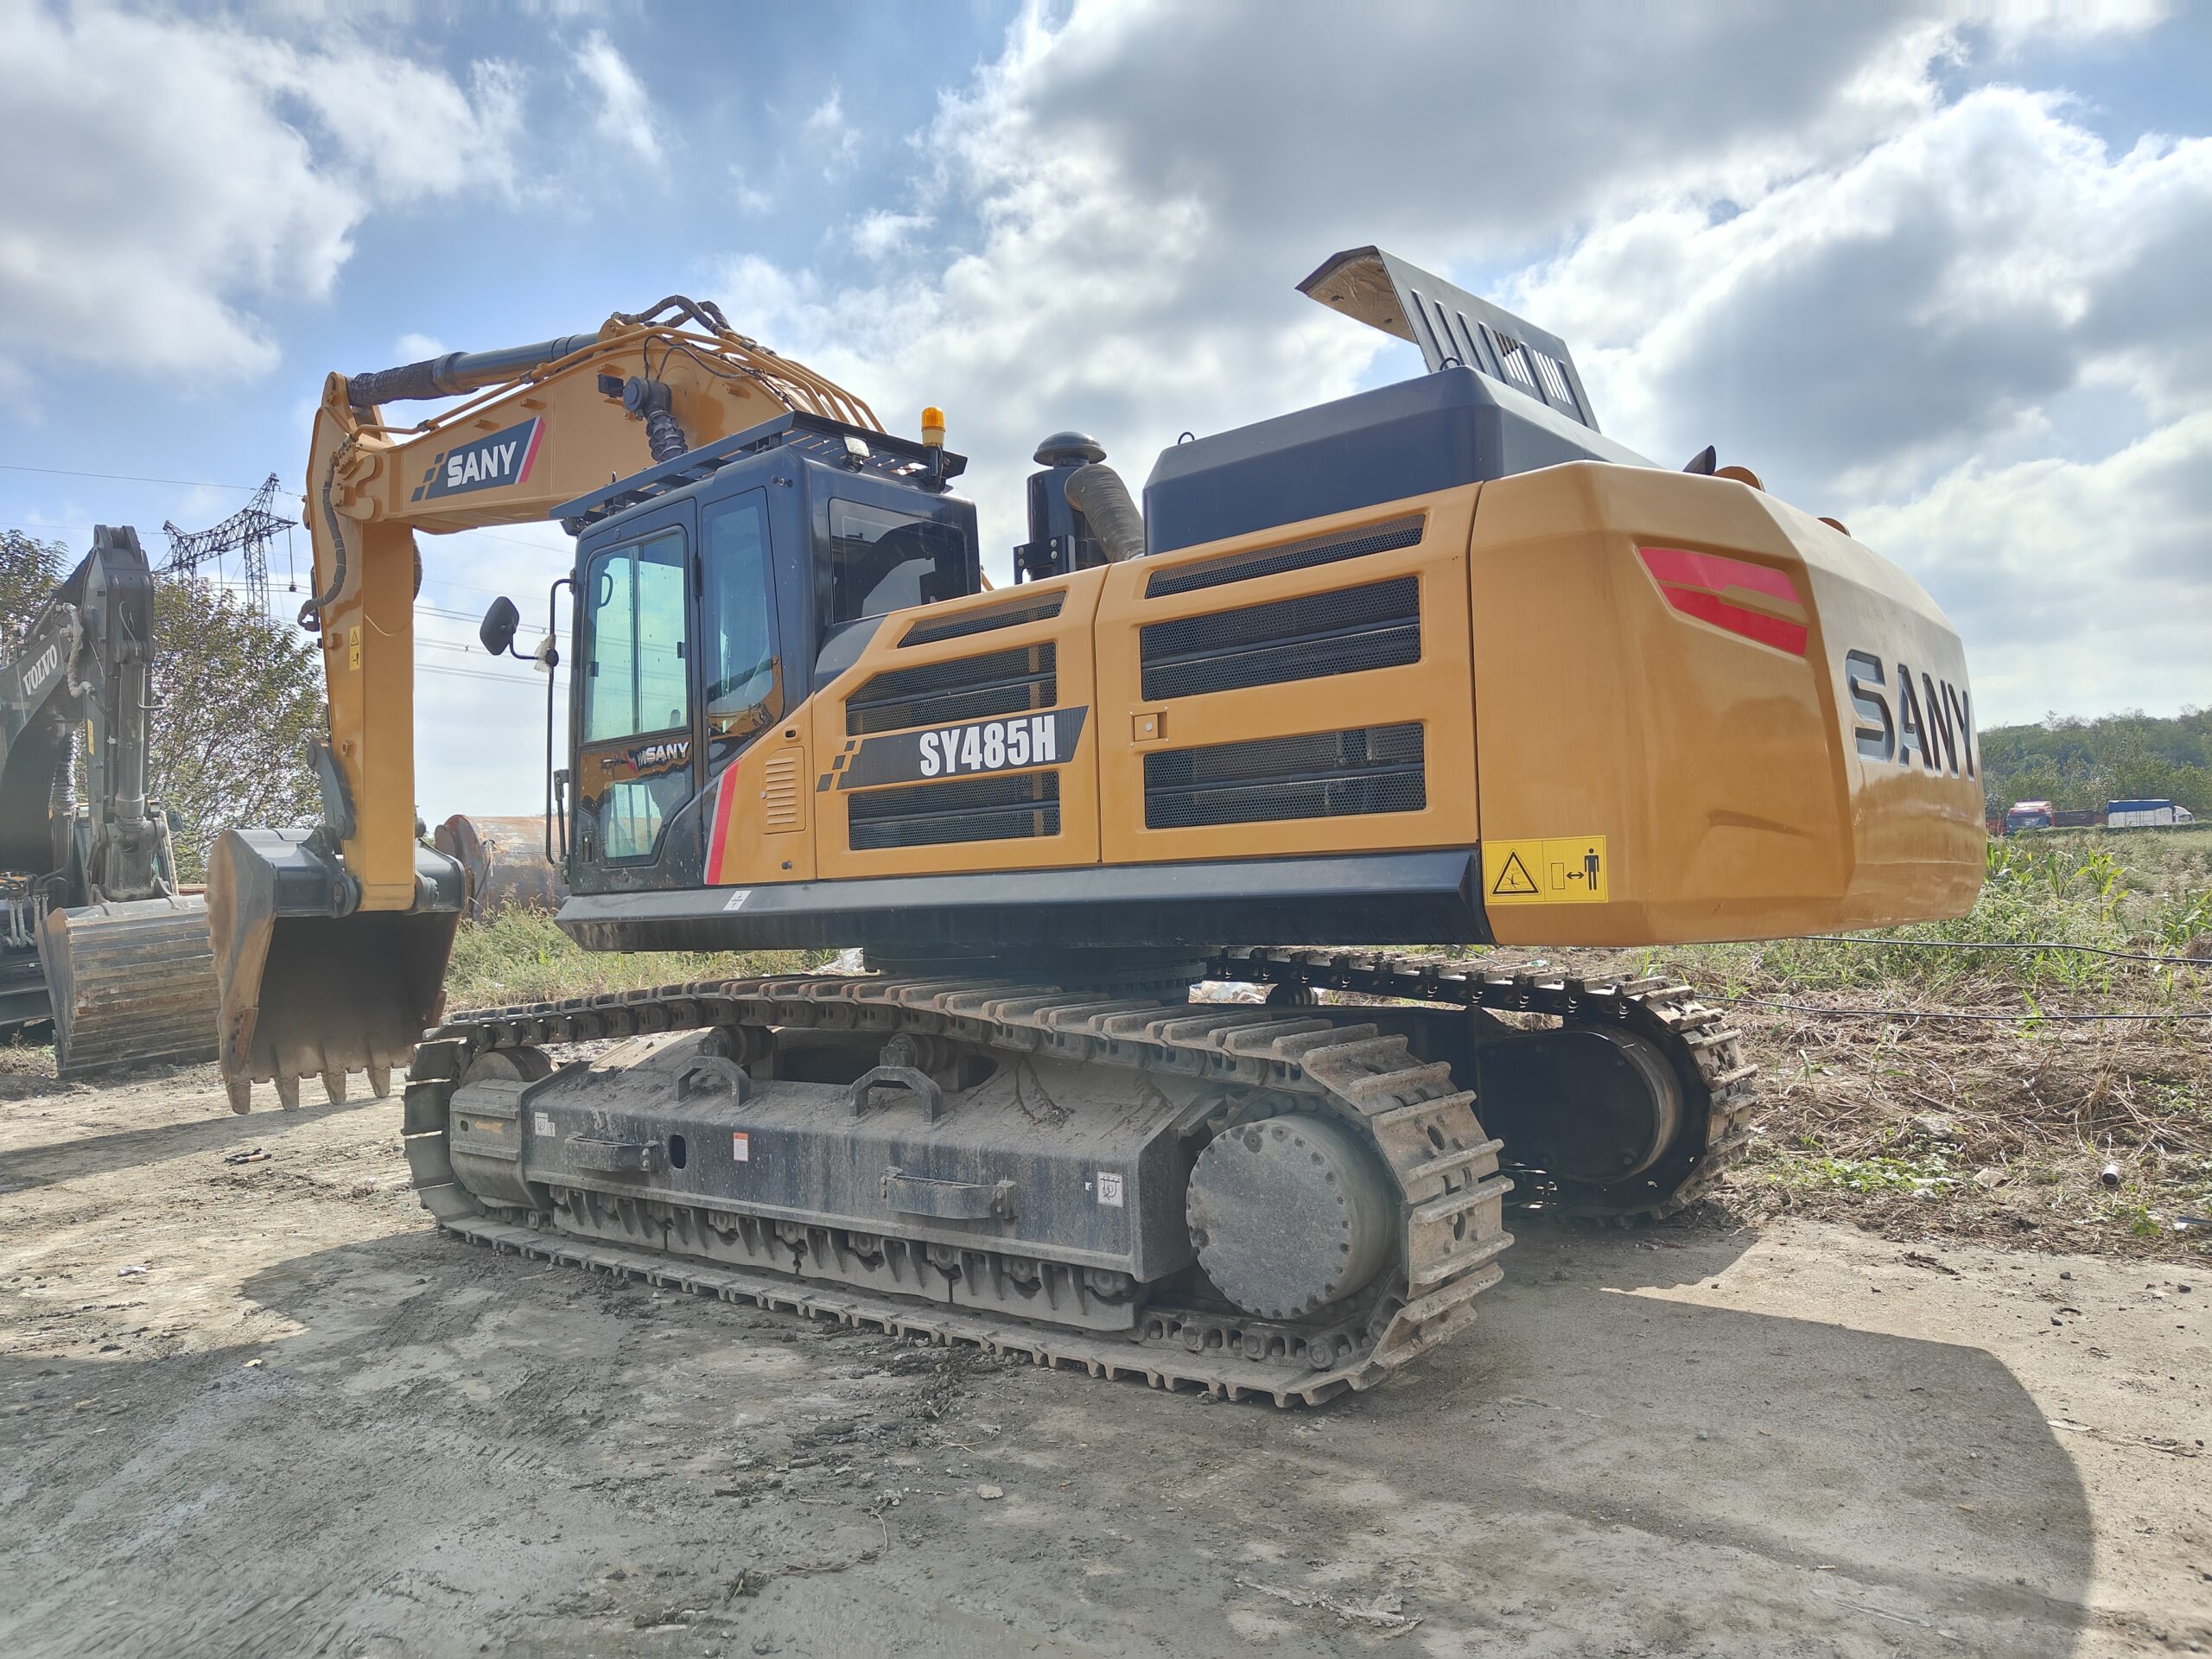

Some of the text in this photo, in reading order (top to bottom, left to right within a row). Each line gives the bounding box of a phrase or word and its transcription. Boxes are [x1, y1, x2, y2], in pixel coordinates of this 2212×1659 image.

[447, 441, 518, 487] SANY
[22, 644, 58, 696] VOLVO
[1845, 649, 1974, 780] SANY
[645, 741, 690, 762] SANY
[919, 715, 1056, 777] SY485H
